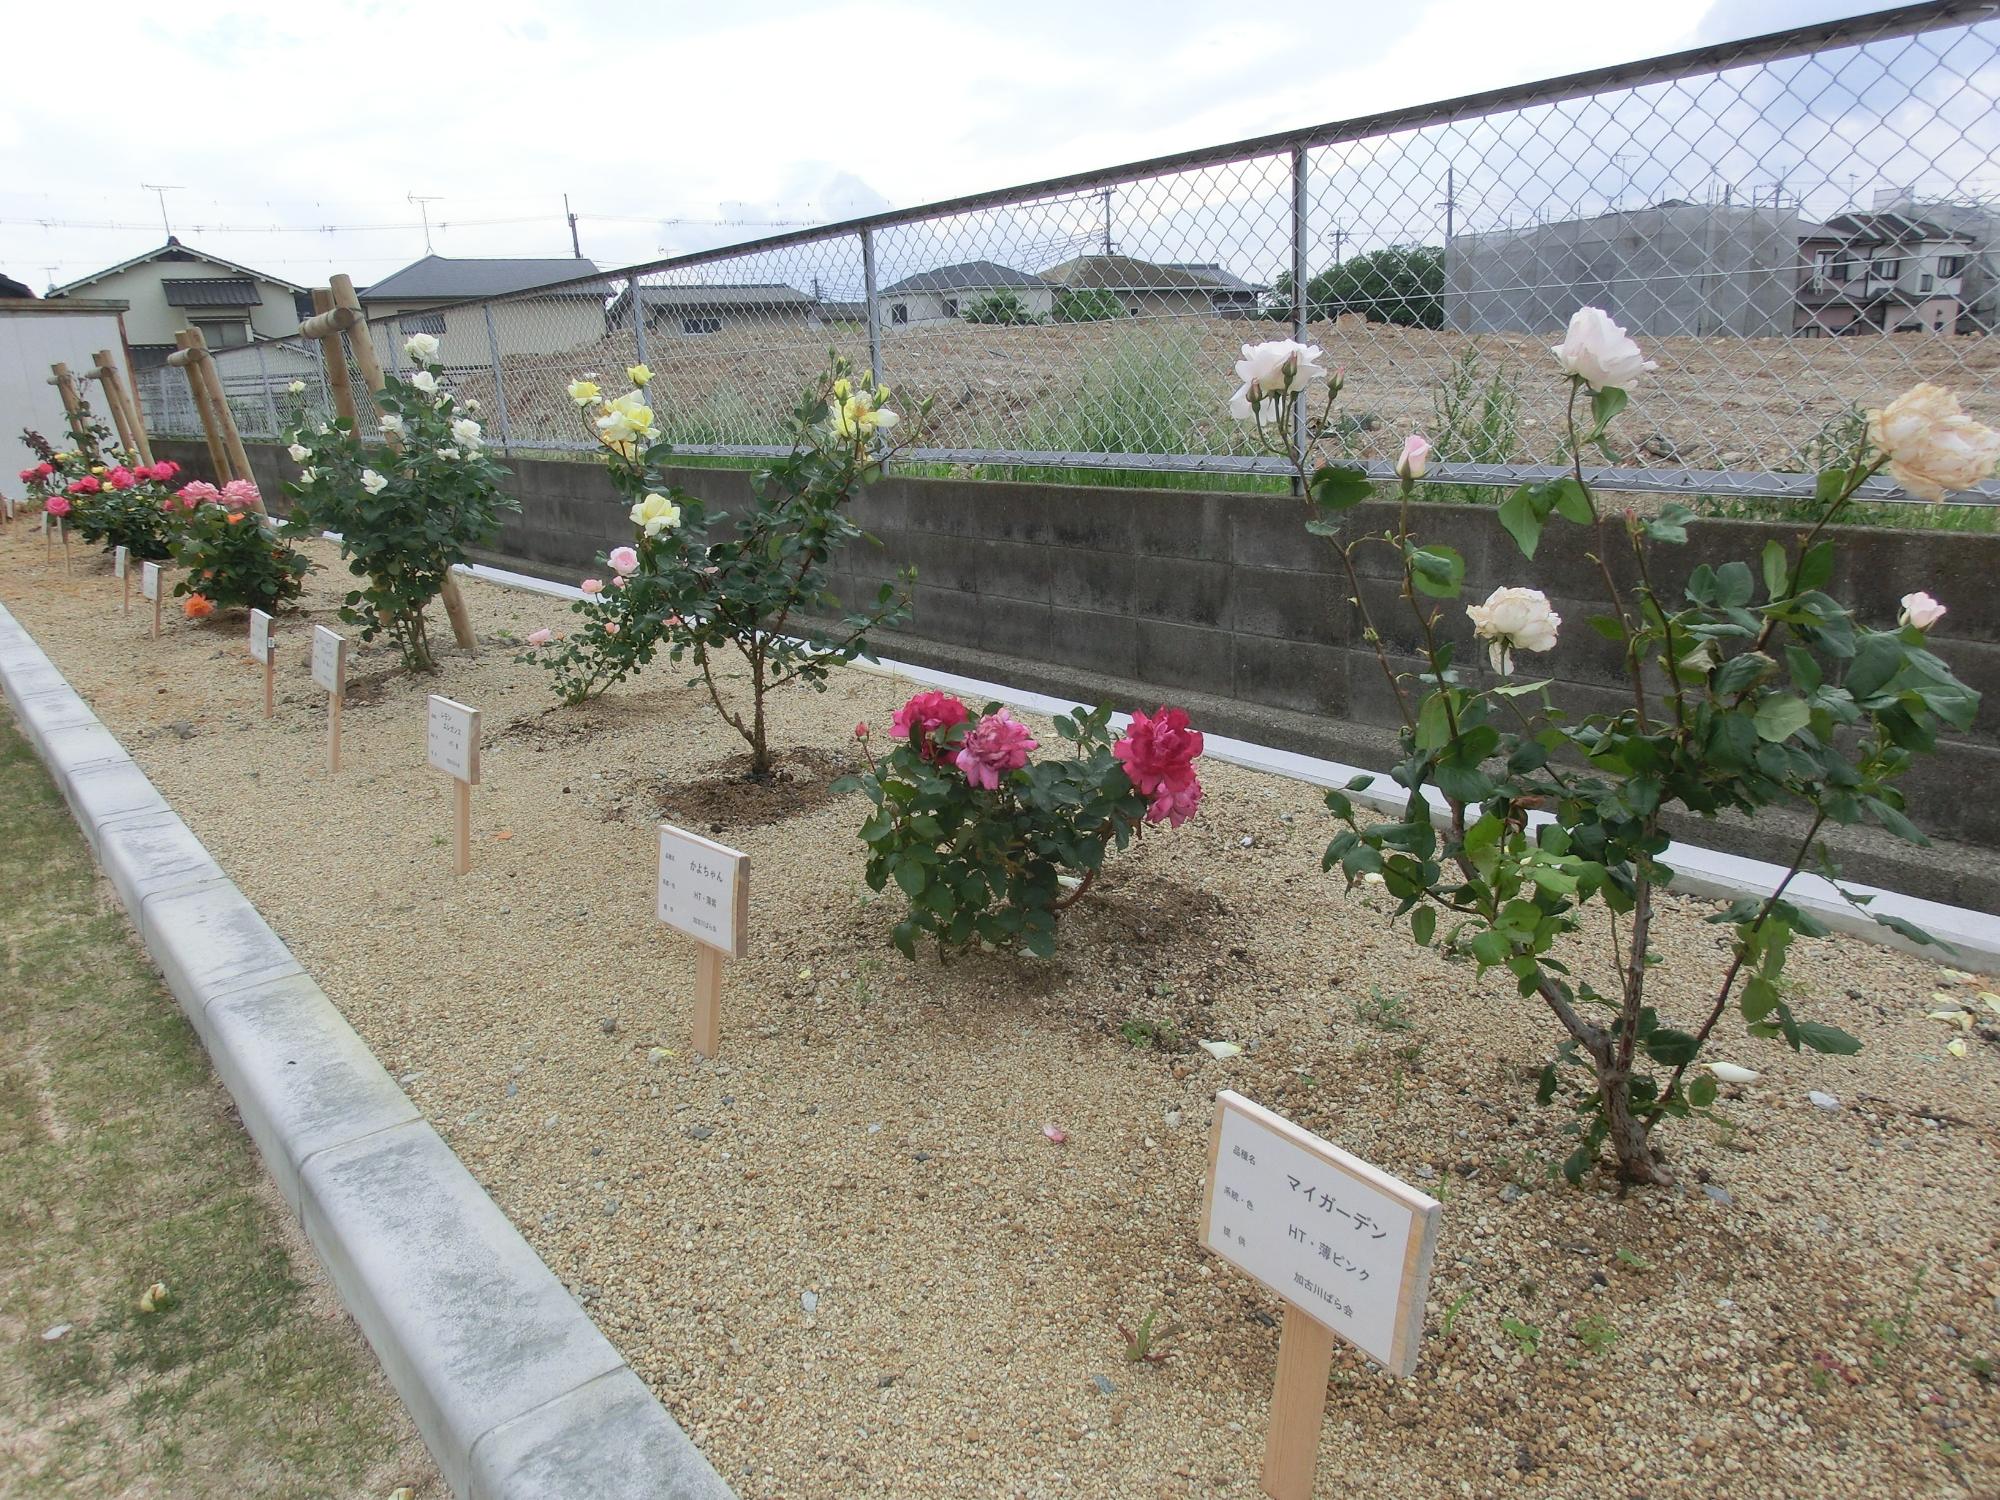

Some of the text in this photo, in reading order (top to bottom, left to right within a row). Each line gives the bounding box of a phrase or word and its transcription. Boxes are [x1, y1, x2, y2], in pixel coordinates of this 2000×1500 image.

[690, 860, 723, 882] かよちゃん
[1232, 1145, 1257, 1166] 品種名
[1286, 1173, 1387, 1240] マイガーデン
[1288, 1223, 1370, 1282] HT・薄ピンク
[1293, 1271, 1354, 1318] 加古川ばら会
